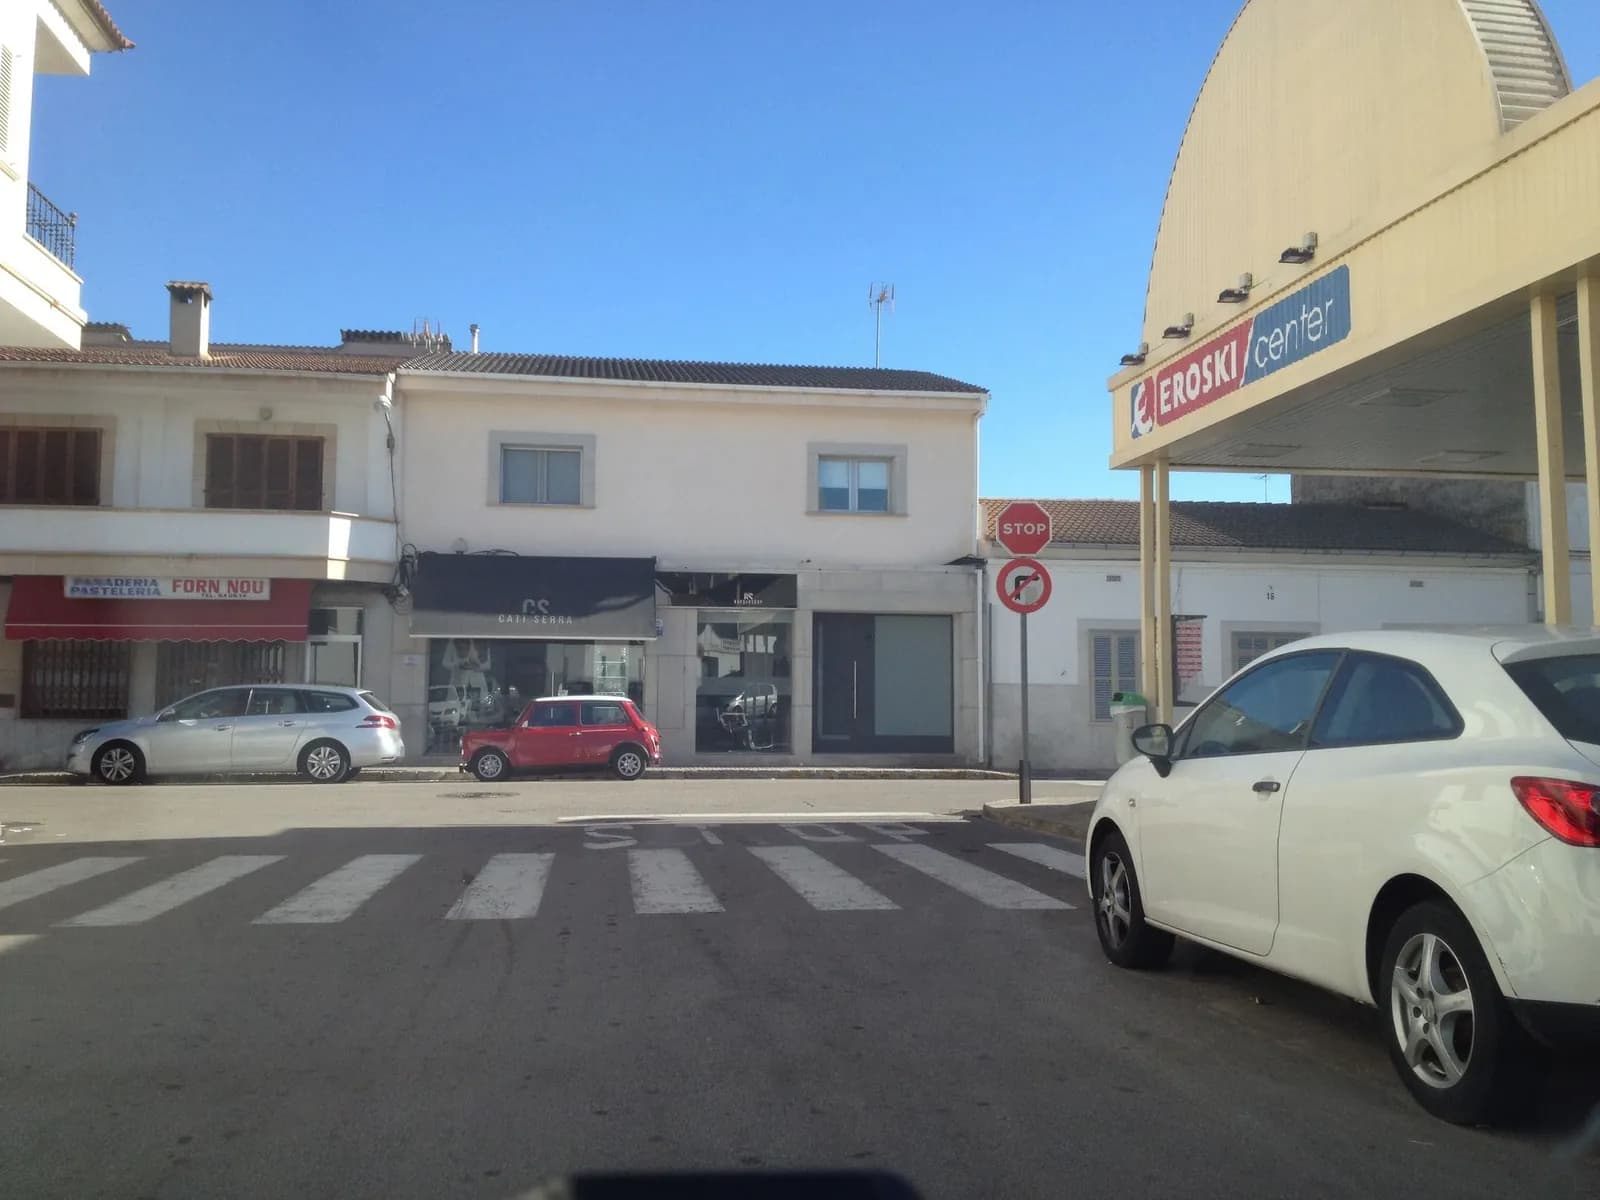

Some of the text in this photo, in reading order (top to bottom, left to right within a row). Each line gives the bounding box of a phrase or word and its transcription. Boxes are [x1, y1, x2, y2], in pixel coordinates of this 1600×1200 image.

[1159, 298, 1333, 415] EROSKI center
[1003, 522, 1046, 535] STOP
[70, 586, 161, 596] PASTELERIA
[172, 579, 264, 594] FORN NOU
[498, 614, 573, 624] CATI SERRA
[583, 822, 930, 849] STOP
